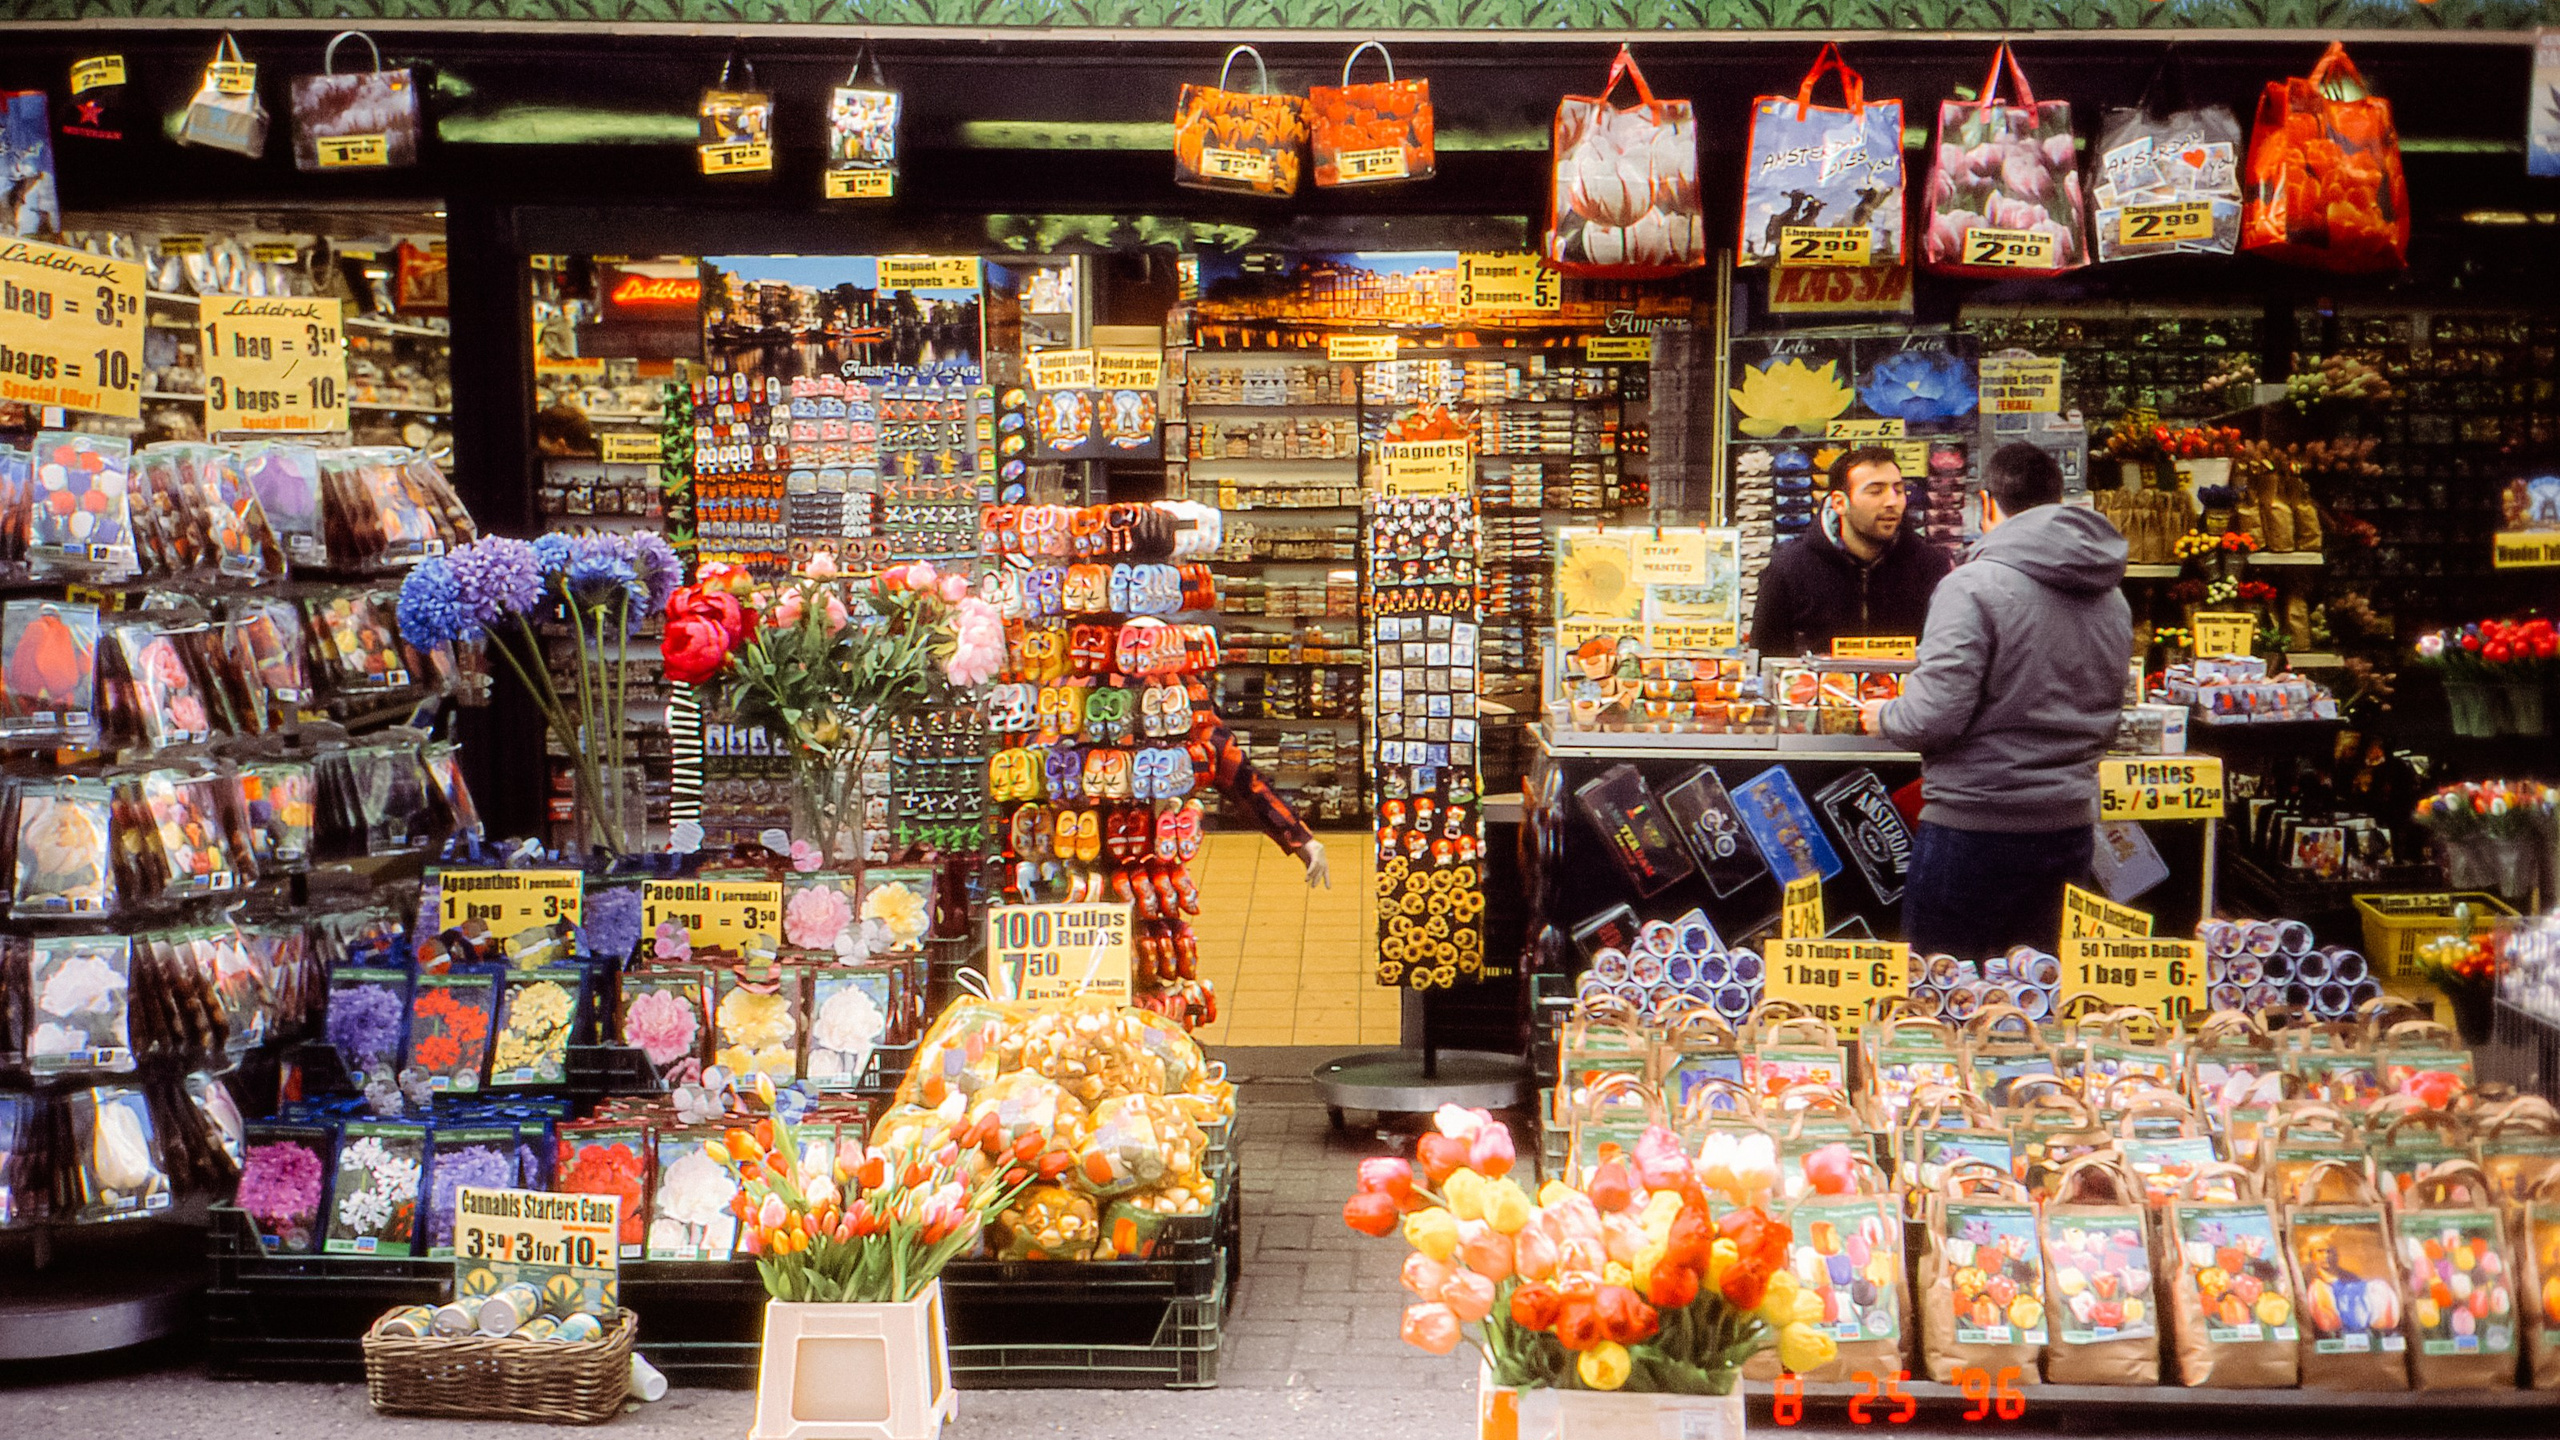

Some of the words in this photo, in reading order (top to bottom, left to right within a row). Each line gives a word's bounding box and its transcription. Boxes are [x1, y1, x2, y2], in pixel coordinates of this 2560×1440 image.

[2124, 204, 2183, 215] Shopping
[2186, 202, 2209, 211] Bag
[1785, 228, 1843, 239] Shopping
[1846, 228, 1869, 239] Bag
[2130, 213, 2199, 238] 2.99
[1970, 230, 2026, 242] Shopping
[2029, 234, 2050, 244] Bag
[1790, 239, 1858, 259] 2.99
[1974, 242, 2041, 264] 2.99
[891, 262, 936, 272] magnet
[1462, 260, 1471, 281] 1
[1475, 267, 1517, 278] magnet
[881, 276, 888, 287] 3
[891, 276, 943, 288] magnets
[1773, 265, 1908, 302] KASSA
[5, 280, 53, 320] bag
[1461, 284, 1472, 306] 3
[1475, 293, 1522, 303] magnets
[223, 300, 322, 320] Laddrak
[205, 322, 219, 356] 1
[234, 332, 272, 361] bag
[1774, 338, 1815, 354] Lotus
[1901, 334, 1946, 351] Lotus
[0, 345, 57, 381] bags
[1101, 357, 1133, 369] Wooden
[1136, 357, 1158, 369] shoes
[2, 380, 56, 403] Special
[210, 376, 226, 410] 3
[235, 387, 280, 412] bags
[1996, 400, 2032, 411] FEMALE
[241, 416, 281, 430] Special
[1383, 445, 1464, 460] Magnets
[1385, 464, 1392, 476] 1
[1399, 466, 1435, 474] magnet
[1643, 546, 1679, 556] STAFF
[1643, 563, 1692, 573] WANTED
[1593, 624, 1617, 633] Your
[1684, 626, 1709, 635] Your
[1836, 640, 1863, 649] Mini
[1867, 639, 1912, 649] Garden
[2125, 763, 2195, 785] Plates
[2145, 788, 2159, 810] 3
[2163, 795, 2180, 806] for
[1854, 792, 1911, 874] AMSTERDAM
[443, 874, 520, 892] Agapanthus
[643, 882, 710, 901] Paeonia
[444, 896, 456, 919] 1
[467, 902, 502, 920] bag
[645, 905, 655, 927] 1
[743, 906, 776, 929] 3.50
[993, 911, 1050, 949] 100
[1054, 911, 1125, 928] Tulips
[1058, 930, 1123, 947] Bulbs
[1785, 943, 1803, 957] 50
[1807, 944, 1850, 960] Tulips
[1854, 945, 1893, 960] Bulbs
[2081, 943, 2099, 957] 50
[2103, 943, 2147, 959] Tulips
[2152, 944, 2191, 959] Bulbs
[1783, 965, 1794, 984] 1
[1800, 965, 1839, 987] bag
[2079, 964, 2089, 984] 1
[2096, 964, 2137, 987] bag
[1806, 1003, 1840, 1021] ags
[462, 1189, 520, 1219] Cannabis
[524, 1194, 577, 1222] Starters
[580, 1198, 613, 1224] Cans
[516, 1232, 534, 1262] 3
[537, 1241, 560, 1262] for
